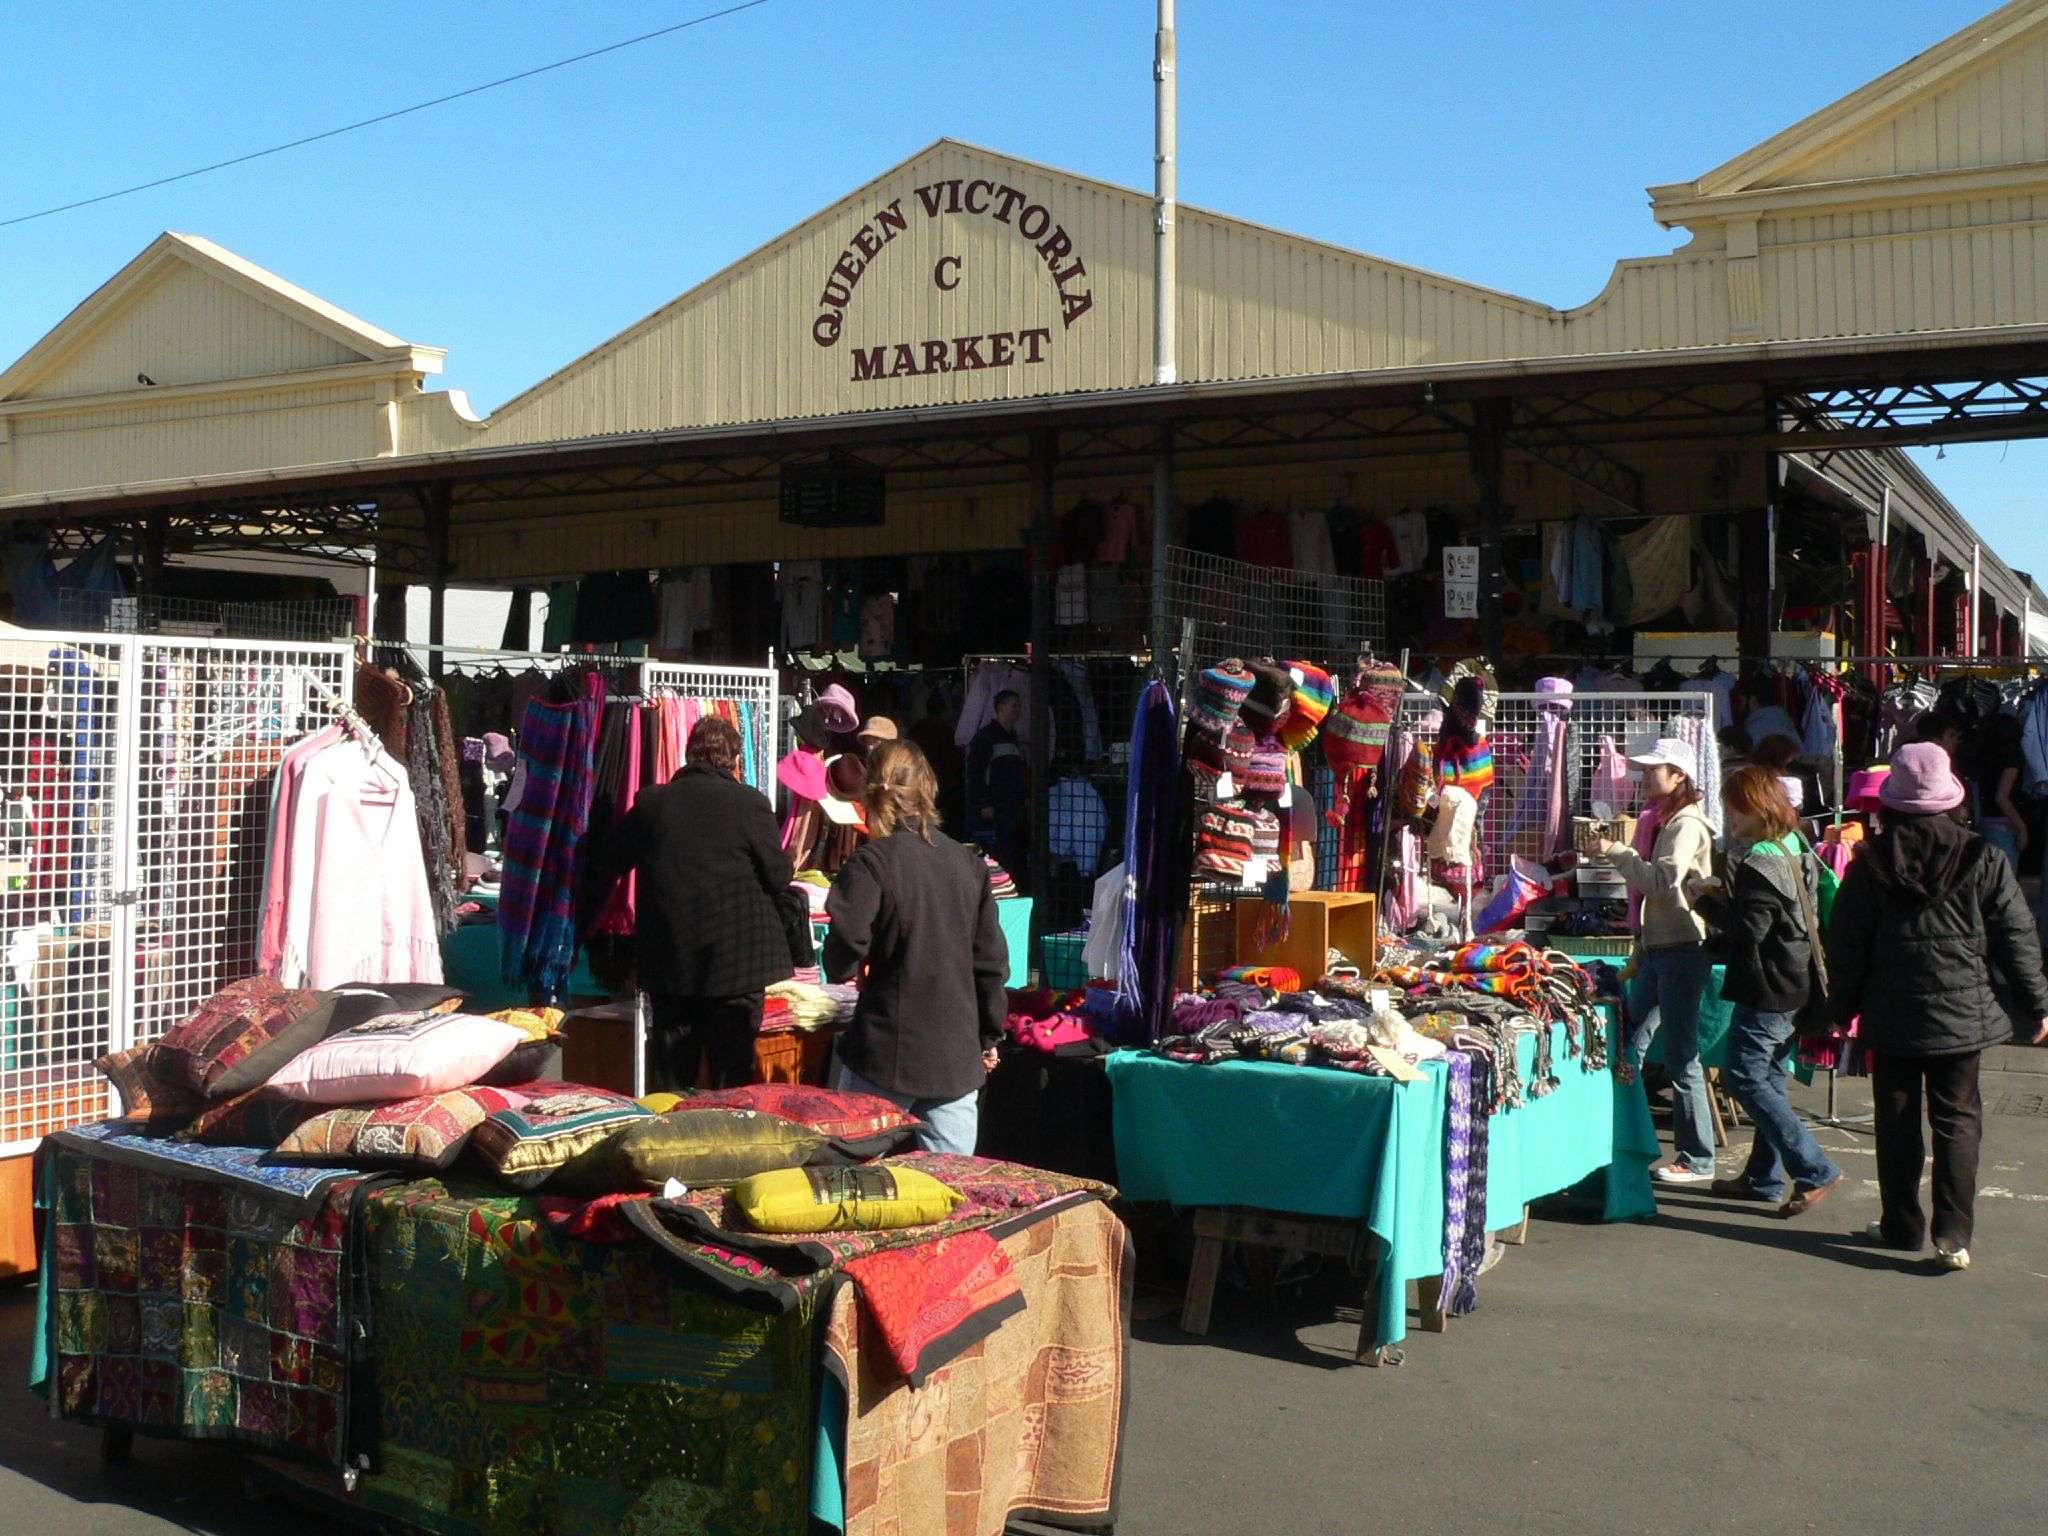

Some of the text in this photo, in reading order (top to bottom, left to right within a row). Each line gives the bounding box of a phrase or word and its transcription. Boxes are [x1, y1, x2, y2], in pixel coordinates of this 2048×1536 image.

[812, 179, 1093, 347] QUEEN VICTORIA
[934, 256, 962, 291] C
[850, 328, 1051, 381] MARKET
